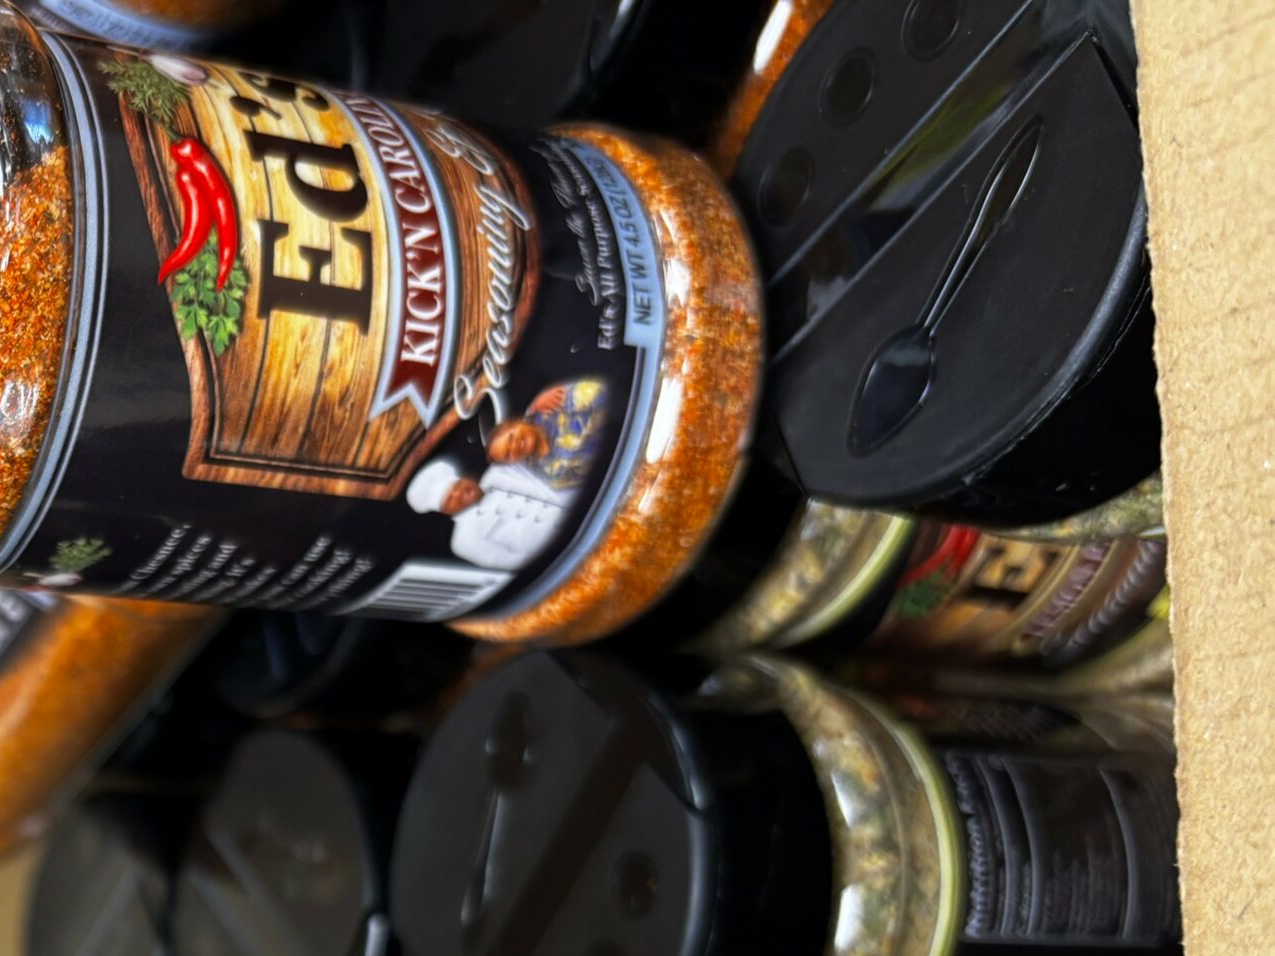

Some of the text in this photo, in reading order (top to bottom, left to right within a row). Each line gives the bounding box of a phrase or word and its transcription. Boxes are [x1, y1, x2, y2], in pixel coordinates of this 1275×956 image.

[331, 91, 431, 213] CAROLIN
[607, 194, 632, 220] OZ
[618, 221, 641, 248] 4.5
[584, 196, 619, 350] Ed's All Purpose
[625, 248, 645, 280] WT
[399, 223, 442, 366] KICK'N
[453, 183, 531, 447] Seasoning
[630, 281, 652, 326] NET
[206, 542, 239, 570] and
